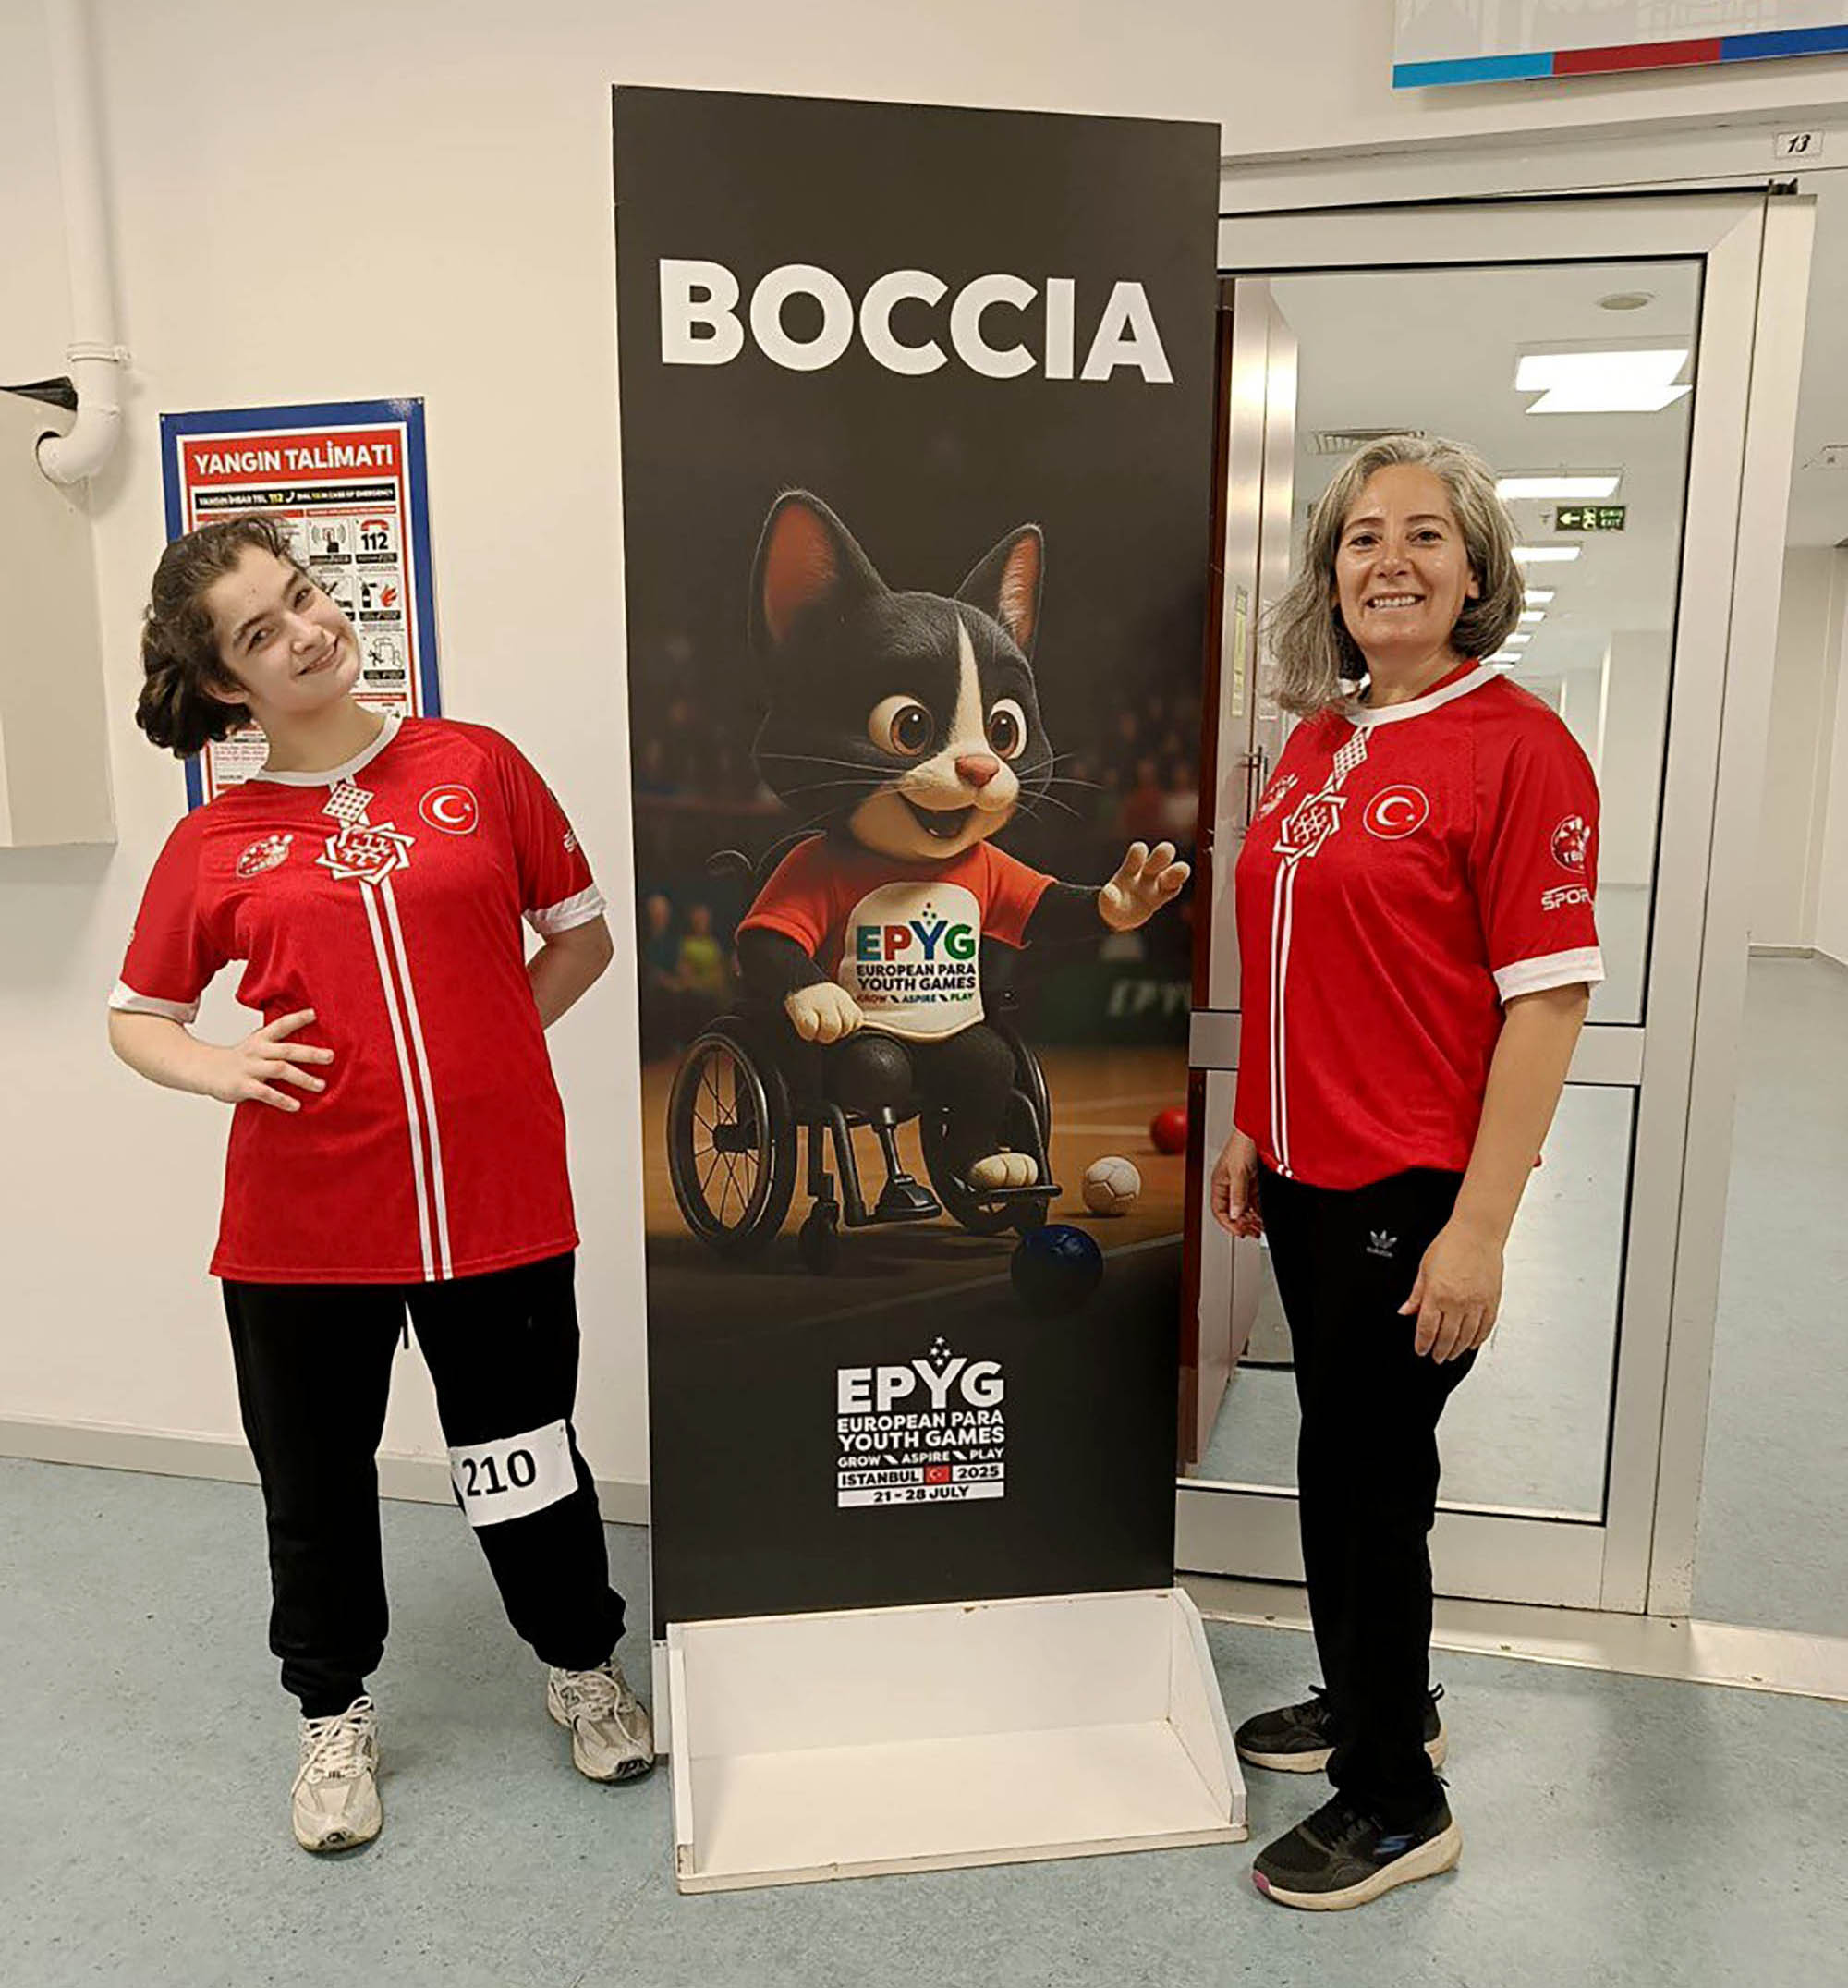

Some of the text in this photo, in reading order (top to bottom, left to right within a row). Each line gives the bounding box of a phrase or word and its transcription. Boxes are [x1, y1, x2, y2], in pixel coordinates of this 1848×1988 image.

[1787, 134, 1811, 153] 13
[659, 258, 1174, 384] BOCCIA
[193, 440, 393, 475] YANGIN TALİMATI
[361, 532, 388, 550] 112
[857, 920, 976, 961] EPYG
[857, 964, 976, 976] EUROPEAN PARA
[857, 976, 976, 991] YOUTH GAMES
[950, 992, 975, 1002] PLAY
[837, 1357, 1004, 1414] EPYG
[837, 1409, 1004, 1433] EUROPEAN PARA
[838, 1426, 1005, 1452] YOUTH GAMES
[838, 1447, 1004, 1468] GROW ASPIRE PLAY
[462, 1448, 537, 1497] 210
[842, 1464, 1000, 1486] ISTANBUL 2025
[874, 1491, 891, 1503] 21
[906, 1488, 926, 1501] 28
[929, 1485, 969, 1499] JULY
